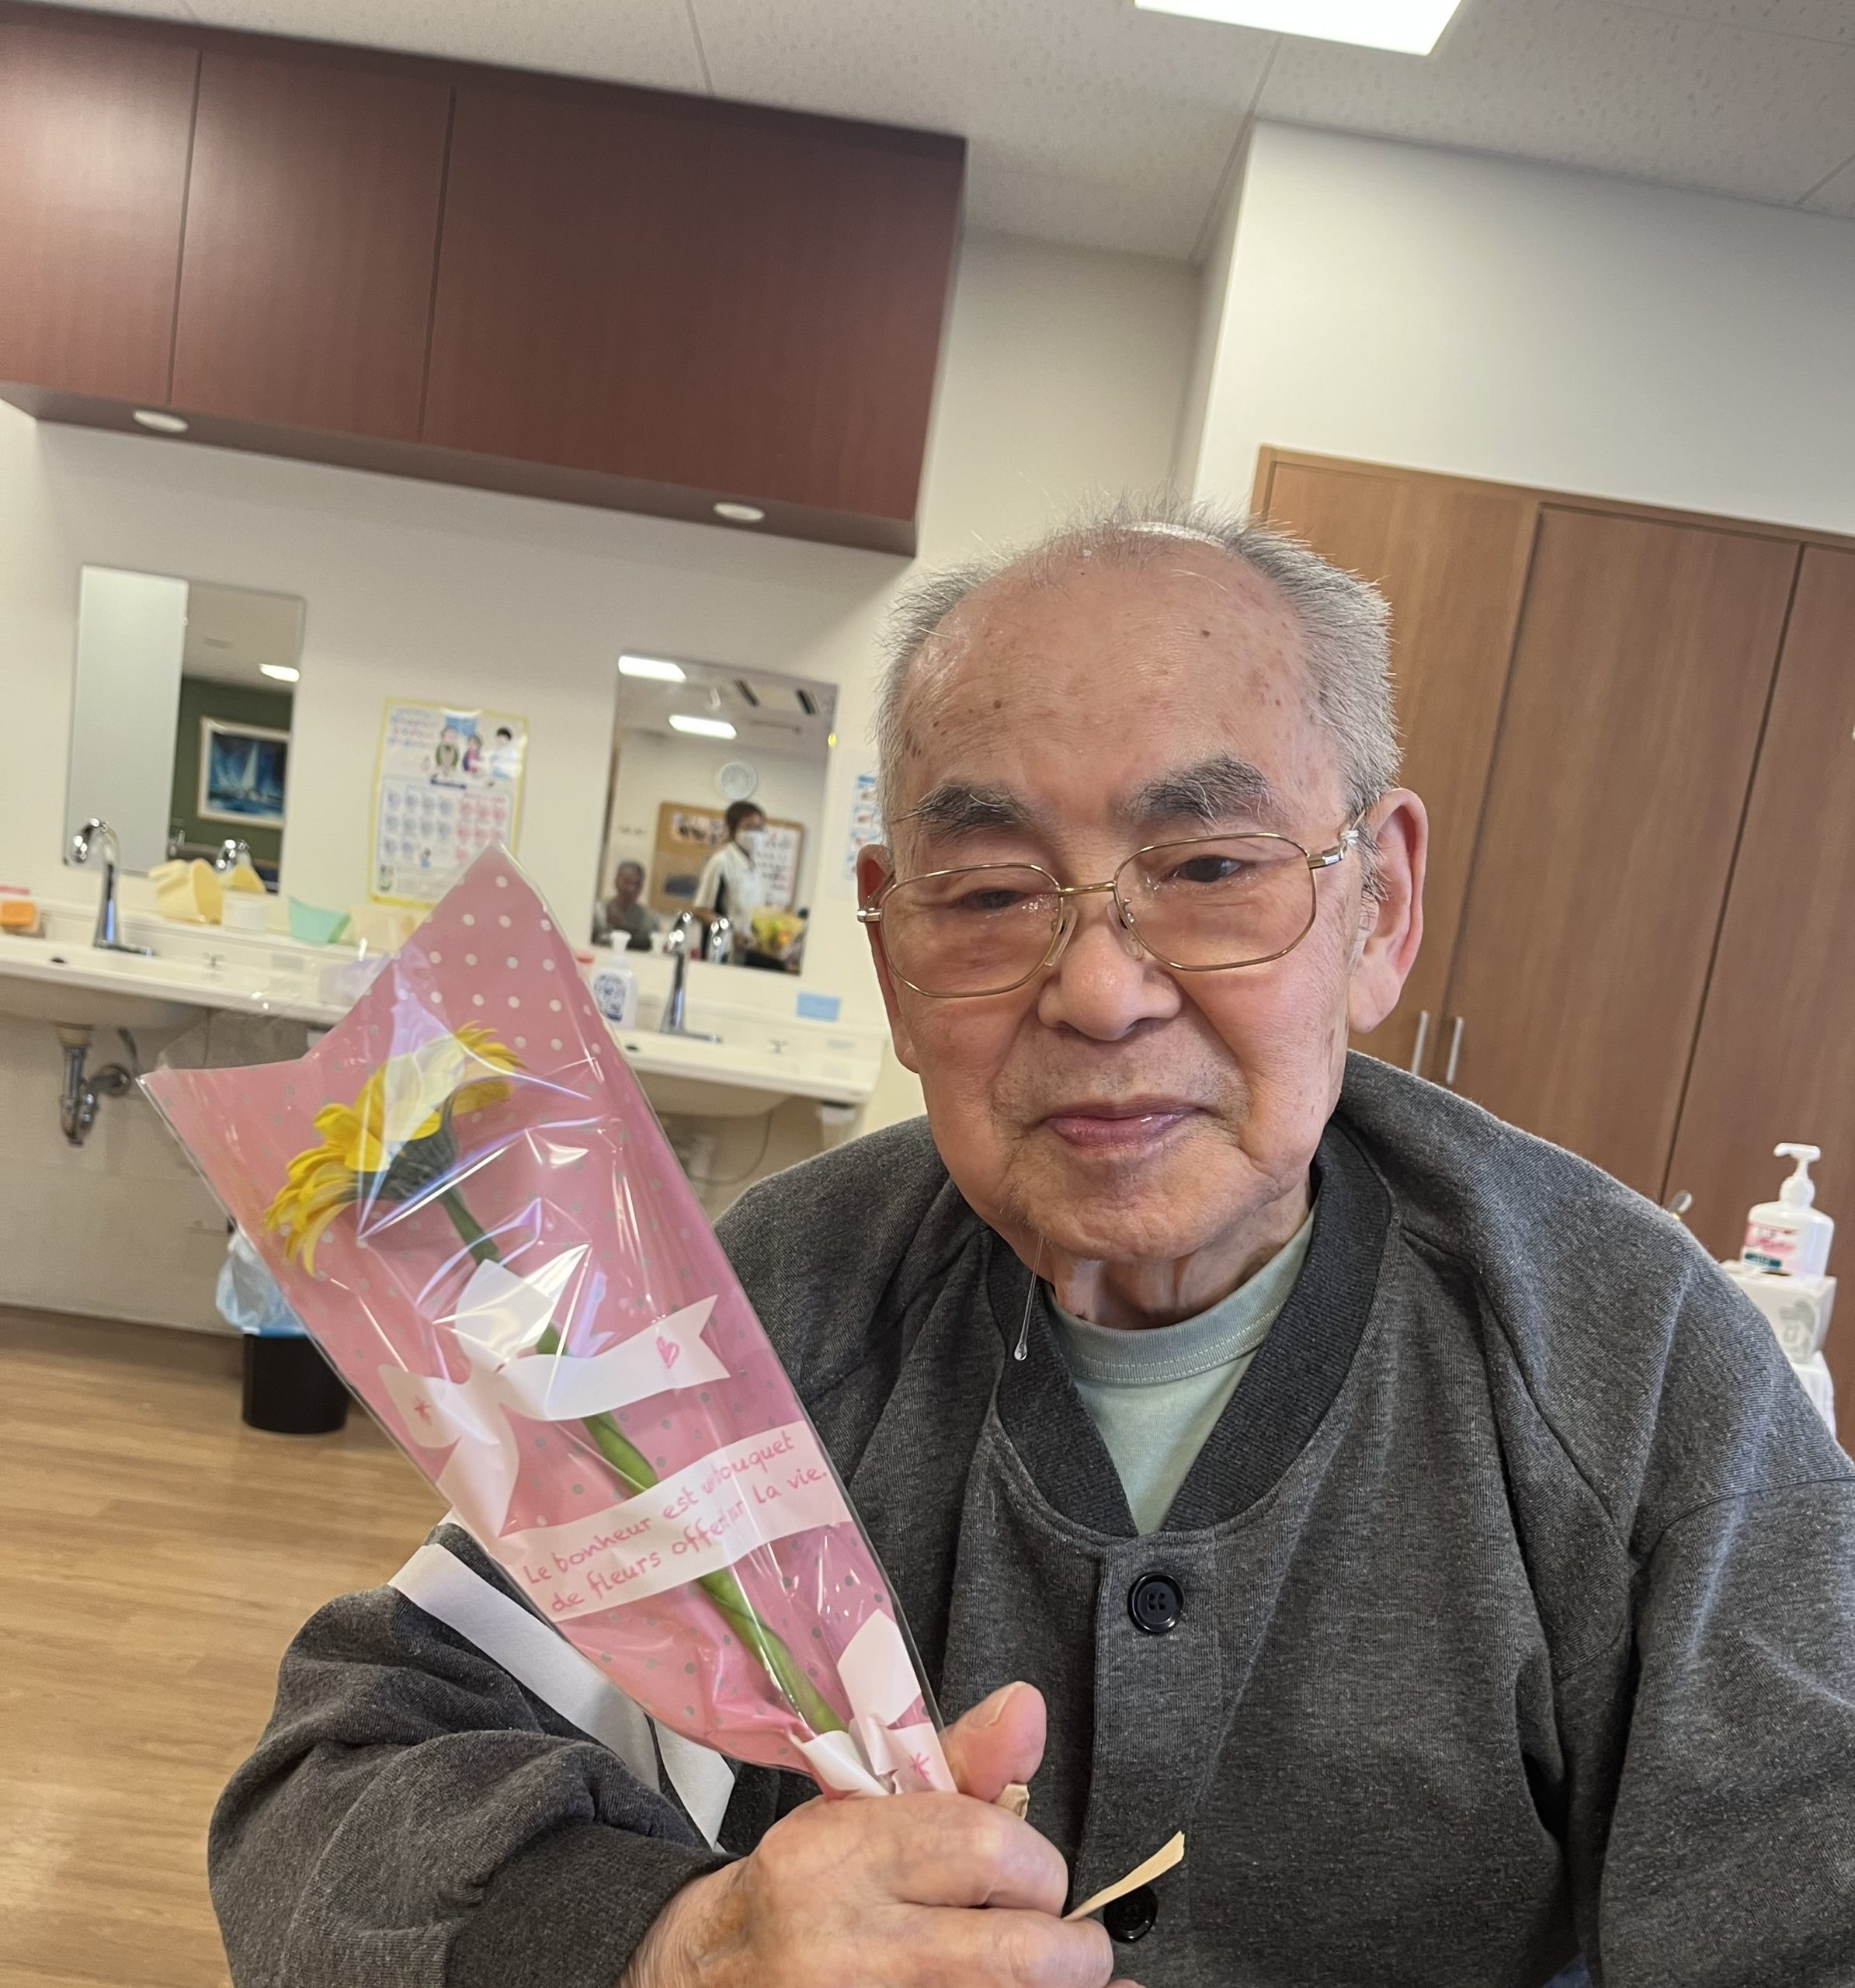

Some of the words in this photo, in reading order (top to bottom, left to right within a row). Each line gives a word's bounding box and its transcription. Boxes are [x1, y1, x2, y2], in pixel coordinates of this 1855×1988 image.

[523, 1566, 553, 1584] Le
[552, 1517, 651, 1574] bonheur
[662, 1486, 699, 1520] est
[552, 1592, 585, 1612] de
[586, 1552, 662, 1600] fleurs
[787, 1467, 828, 1489] vie.
